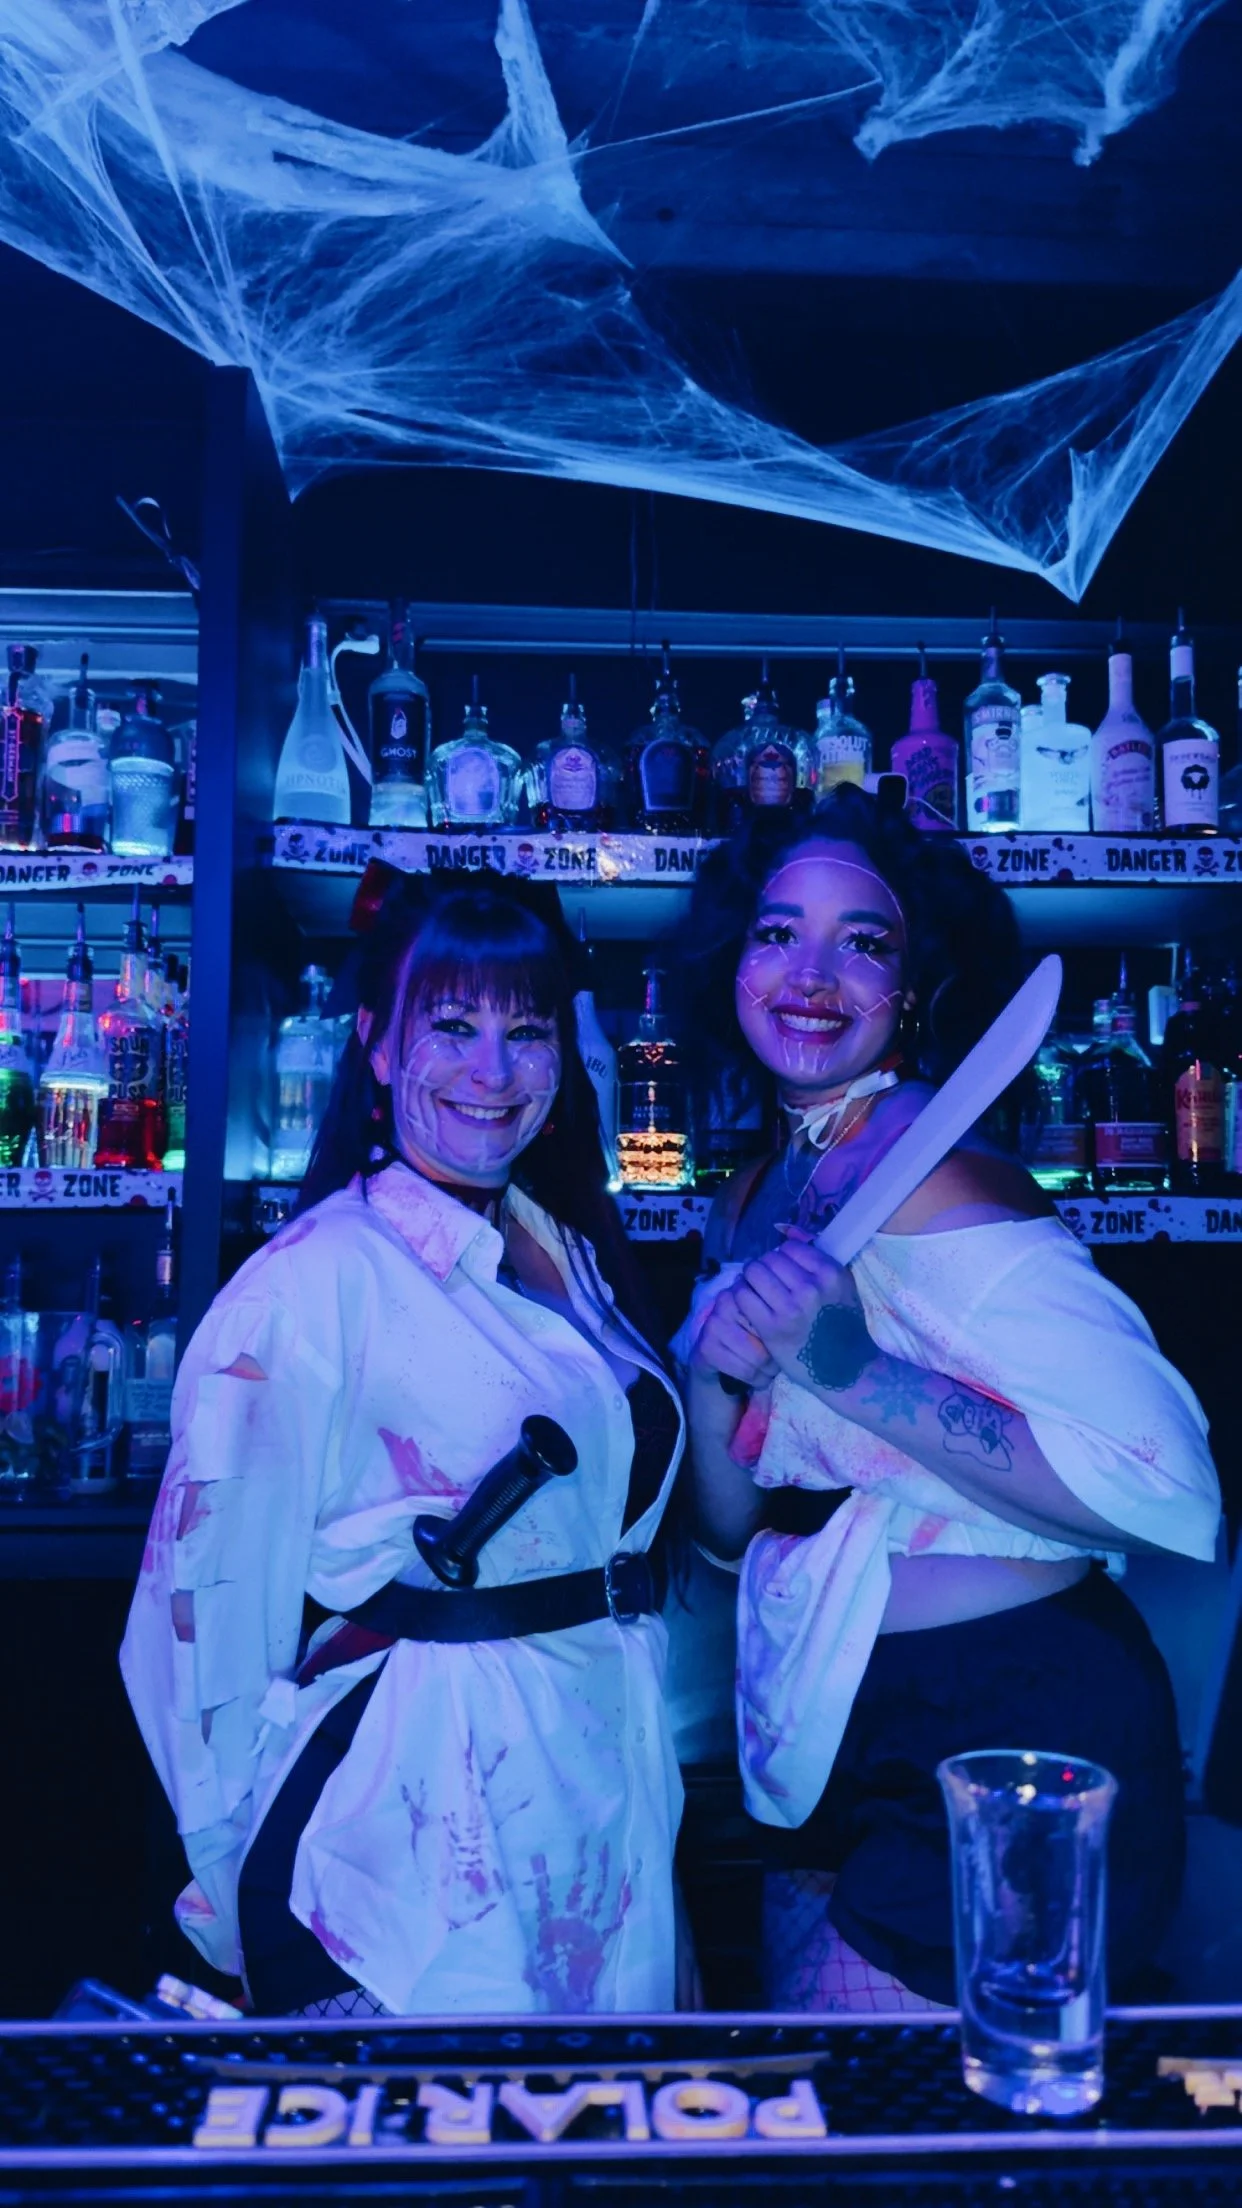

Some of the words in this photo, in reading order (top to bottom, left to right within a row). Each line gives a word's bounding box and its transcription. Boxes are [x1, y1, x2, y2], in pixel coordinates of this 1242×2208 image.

[380, 746, 418, 760] GHOST
[314, 841, 372, 865] ZONE
[426, 845, 506, 870] DANGER
[544, 847, 596, 871] ZONE
[654, 848, 700, 872] DAN
[997, 849, 1050, 872] ZONE
[1106, 848, 1187, 872] DANGER
[107, 863, 157, 879] ZONE
[586, 1056, 608, 1079] IBU
[63, 1174, 122, 1197] ZONE
[624, 1208, 680, 1232] ZONE
[1091, 1209, 1147, 1234] ZONE
[1205, 1209, 1242, 1234] DAN
[194, 2082, 377, 2147] ICE
[419, 2080, 827, 2144] POLAR
